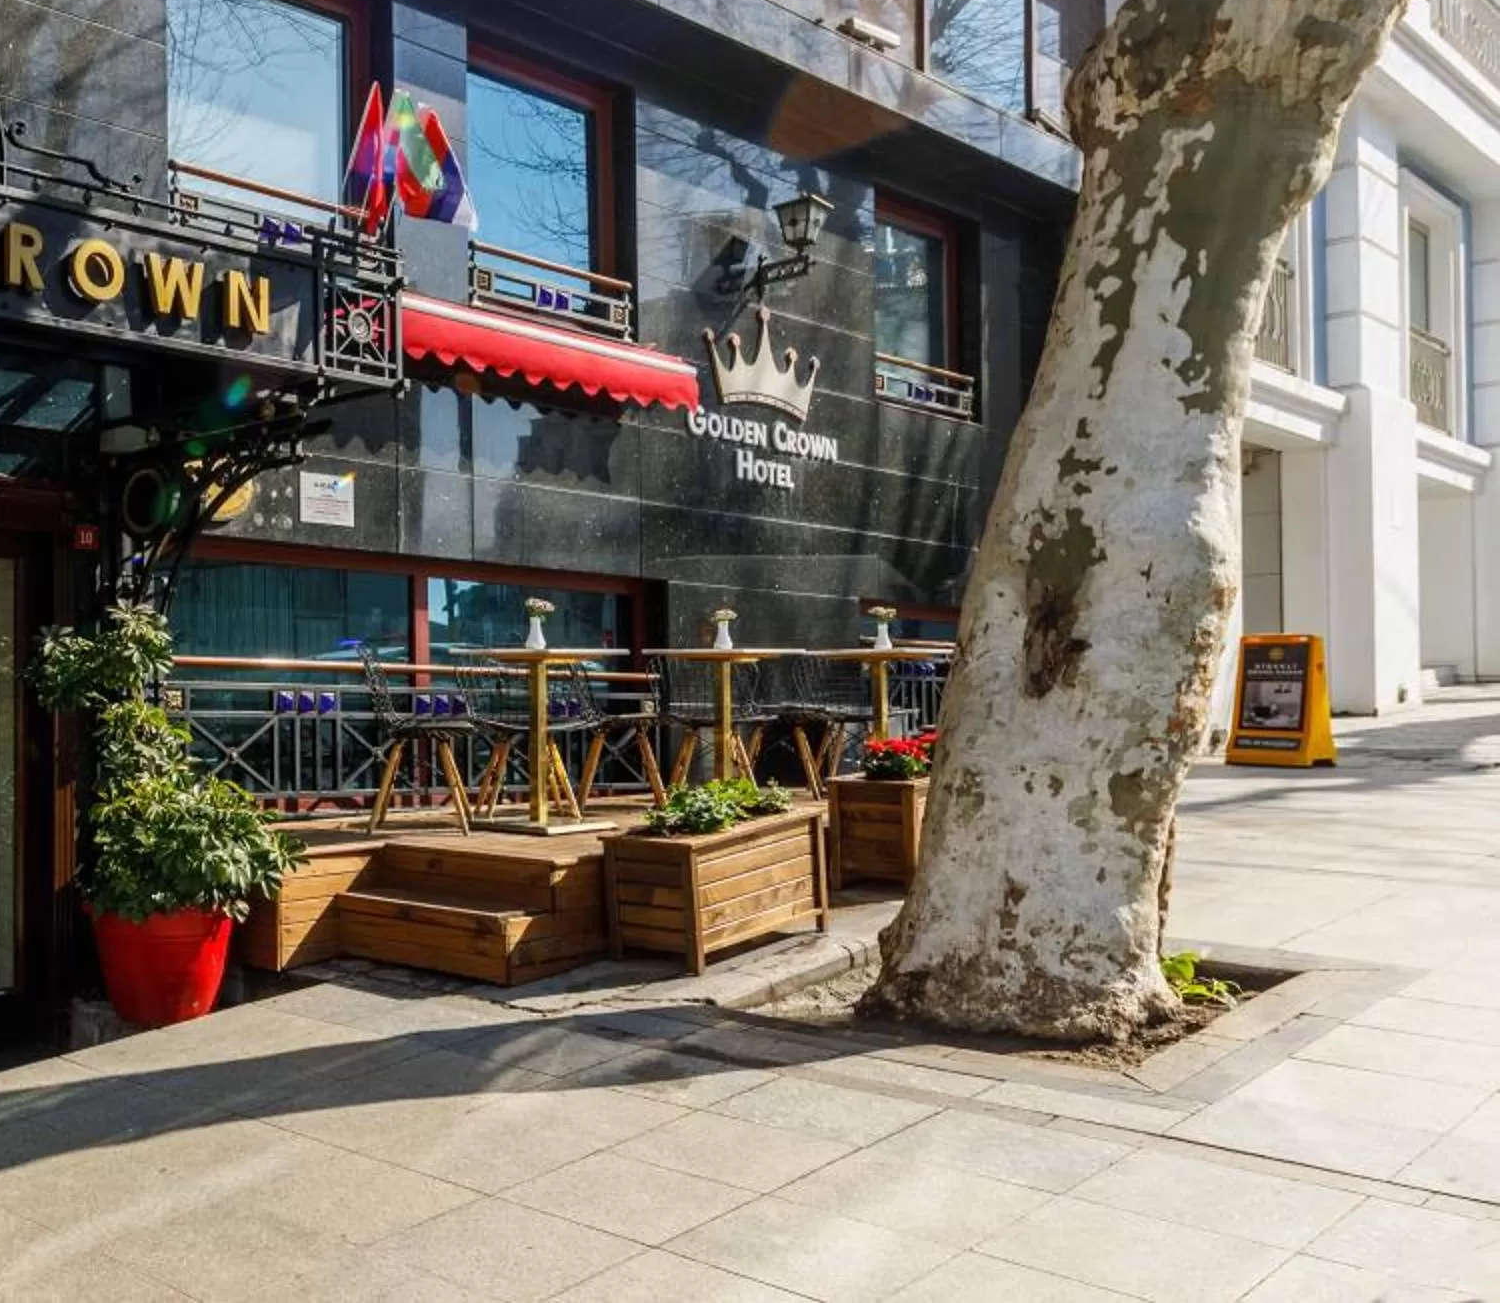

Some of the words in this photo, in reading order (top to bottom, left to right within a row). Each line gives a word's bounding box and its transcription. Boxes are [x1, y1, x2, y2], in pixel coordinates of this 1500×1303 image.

[688, 404, 768, 447] GOLDEN
[773, 420, 838, 461] CROWN
[736, 449, 795, 489] HOTEL
